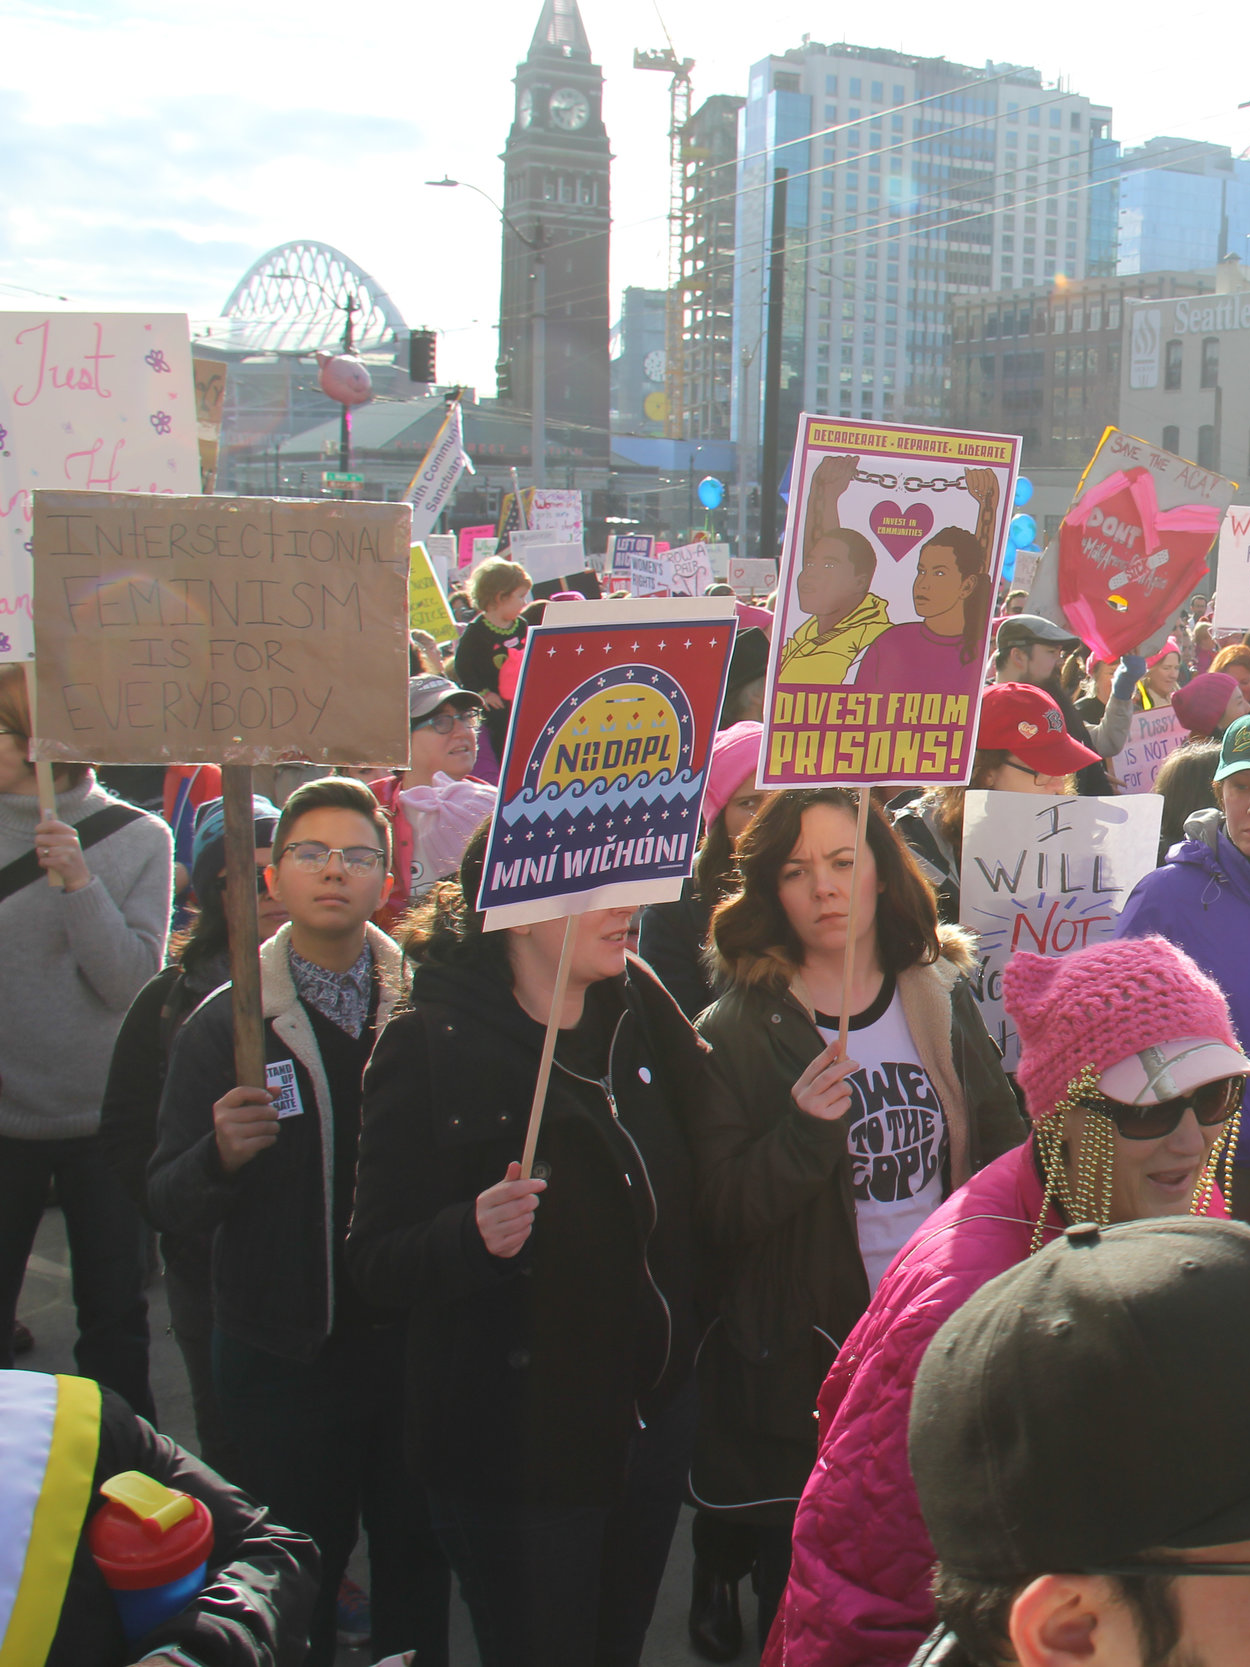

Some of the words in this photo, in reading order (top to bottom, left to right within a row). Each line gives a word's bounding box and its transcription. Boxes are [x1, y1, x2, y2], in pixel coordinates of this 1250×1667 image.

[814, 429, 888, 448] DECARCERATE
[958, 443, 1006, 460] LIBERATE
[1110, 436, 1142, 460] SAVE
[1149, 453, 1170, 472] THE
[1174, 466, 1222, 499] ACA!
[877, 526, 923, 537] COMMUNITIES
[883, 517, 906, 526] INVEST
[909, 518, 917, 526] IN
[62, 574, 364, 633] FEMINISM
[130, 639, 191, 669] IS
[209, 639, 294, 674] FOR
[62, 681, 333, 734] EVERYBODY
[773, 691, 884, 725] DIVEST
[886, 692, 970, 726] FROM
[1139, 714, 1178, 739] PUSSY
[769, 730, 964, 776] PRISONS!
[1124, 748, 1137, 766] IS
[1143, 739, 1168, 762] NOT
[1036, 799, 1078, 842] I
[491, 844, 562, 891] MNÍ
[974, 849, 1125, 893] WILL
[1011, 901, 1111, 955] NOT
[281, 1073, 294, 1085] UP
[850, 1116, 884, 1154] TO
[885, 1108, 936, 1151] THE
[851, 1137, 940, 1203] EOPL
